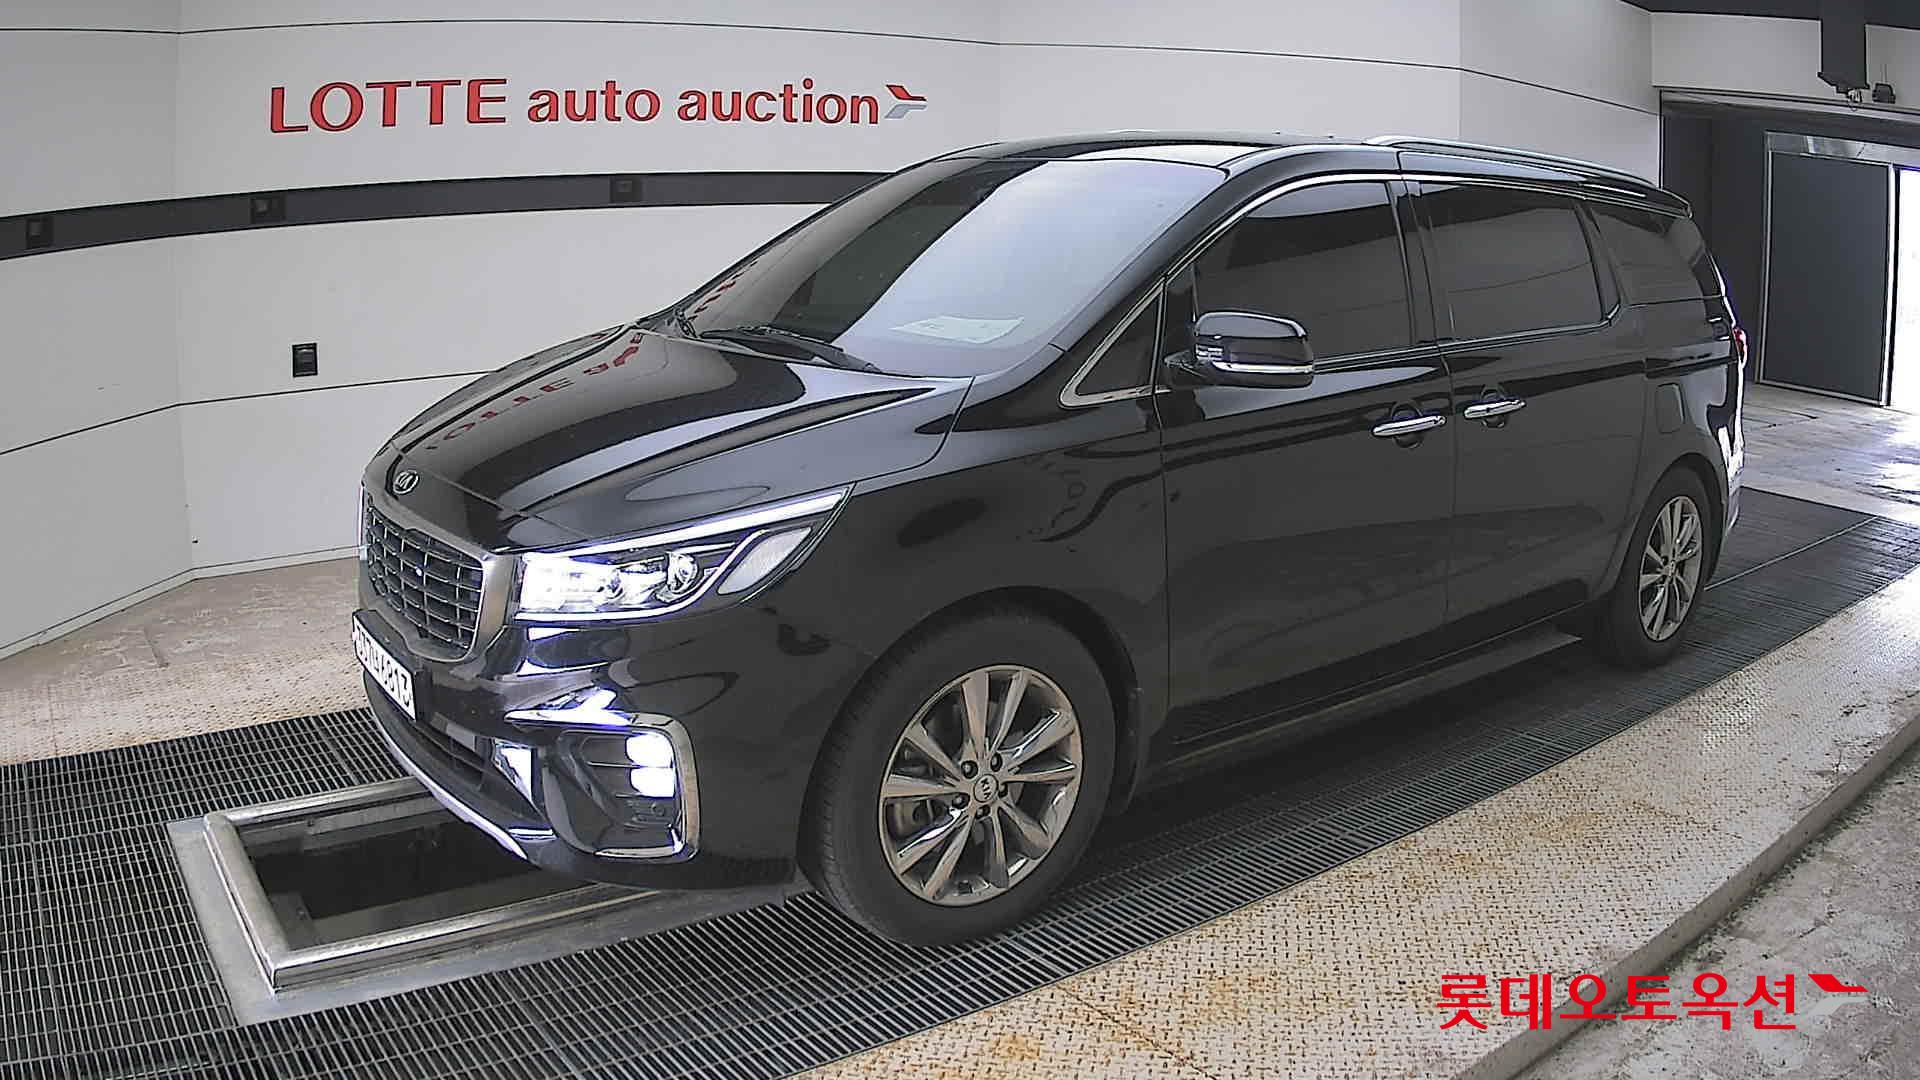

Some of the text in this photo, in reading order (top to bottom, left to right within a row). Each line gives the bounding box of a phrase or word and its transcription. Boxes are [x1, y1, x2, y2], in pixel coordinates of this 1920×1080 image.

[270, 78, 880, 134] LOTTE auto auction
